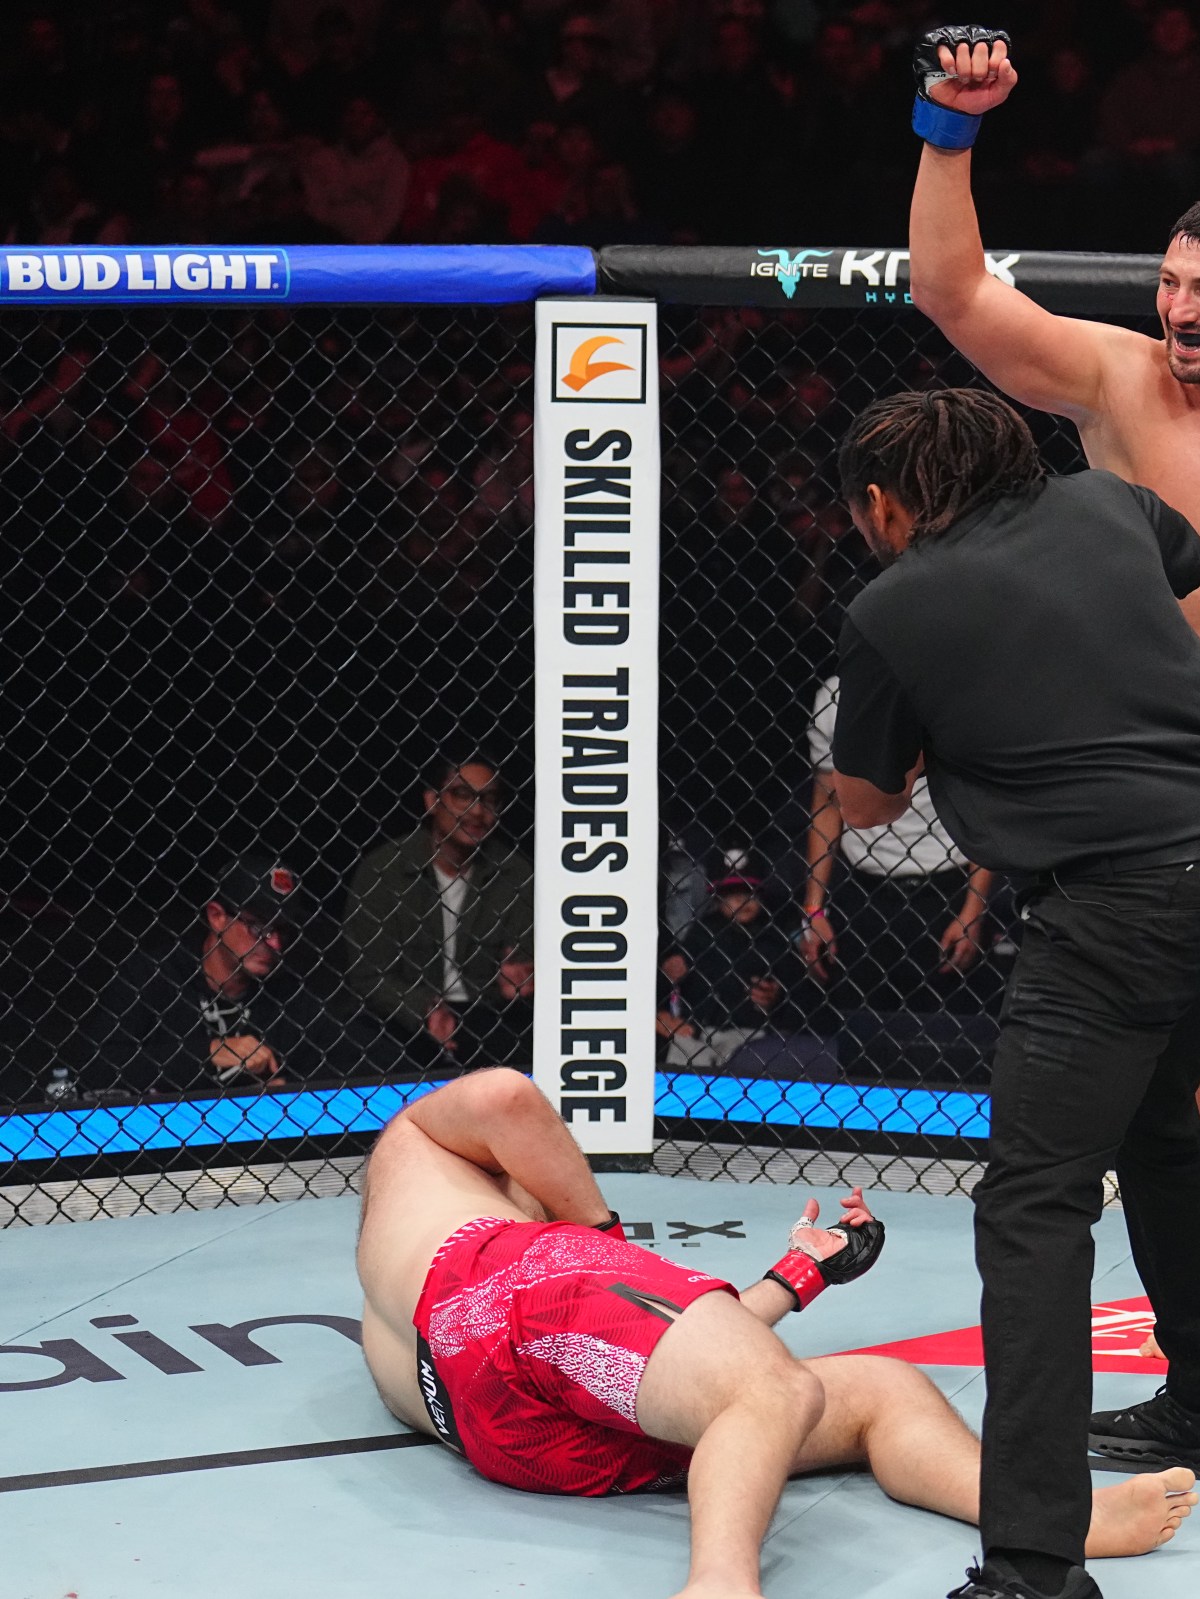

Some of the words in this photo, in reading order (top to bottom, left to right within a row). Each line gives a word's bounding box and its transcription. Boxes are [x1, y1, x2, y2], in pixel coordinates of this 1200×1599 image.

[6, 254, 121, 291] BUD
[125, 253, 279, 291] LIGHT
[750, 262, 829, 278] IGNITE
[839, 250, 1021, 287] KNX
[563, 428, 633, 646] SKILLED
[561, 667, 630, 874] TRADES
[559, 894, 629, 1123] COLLEGE
